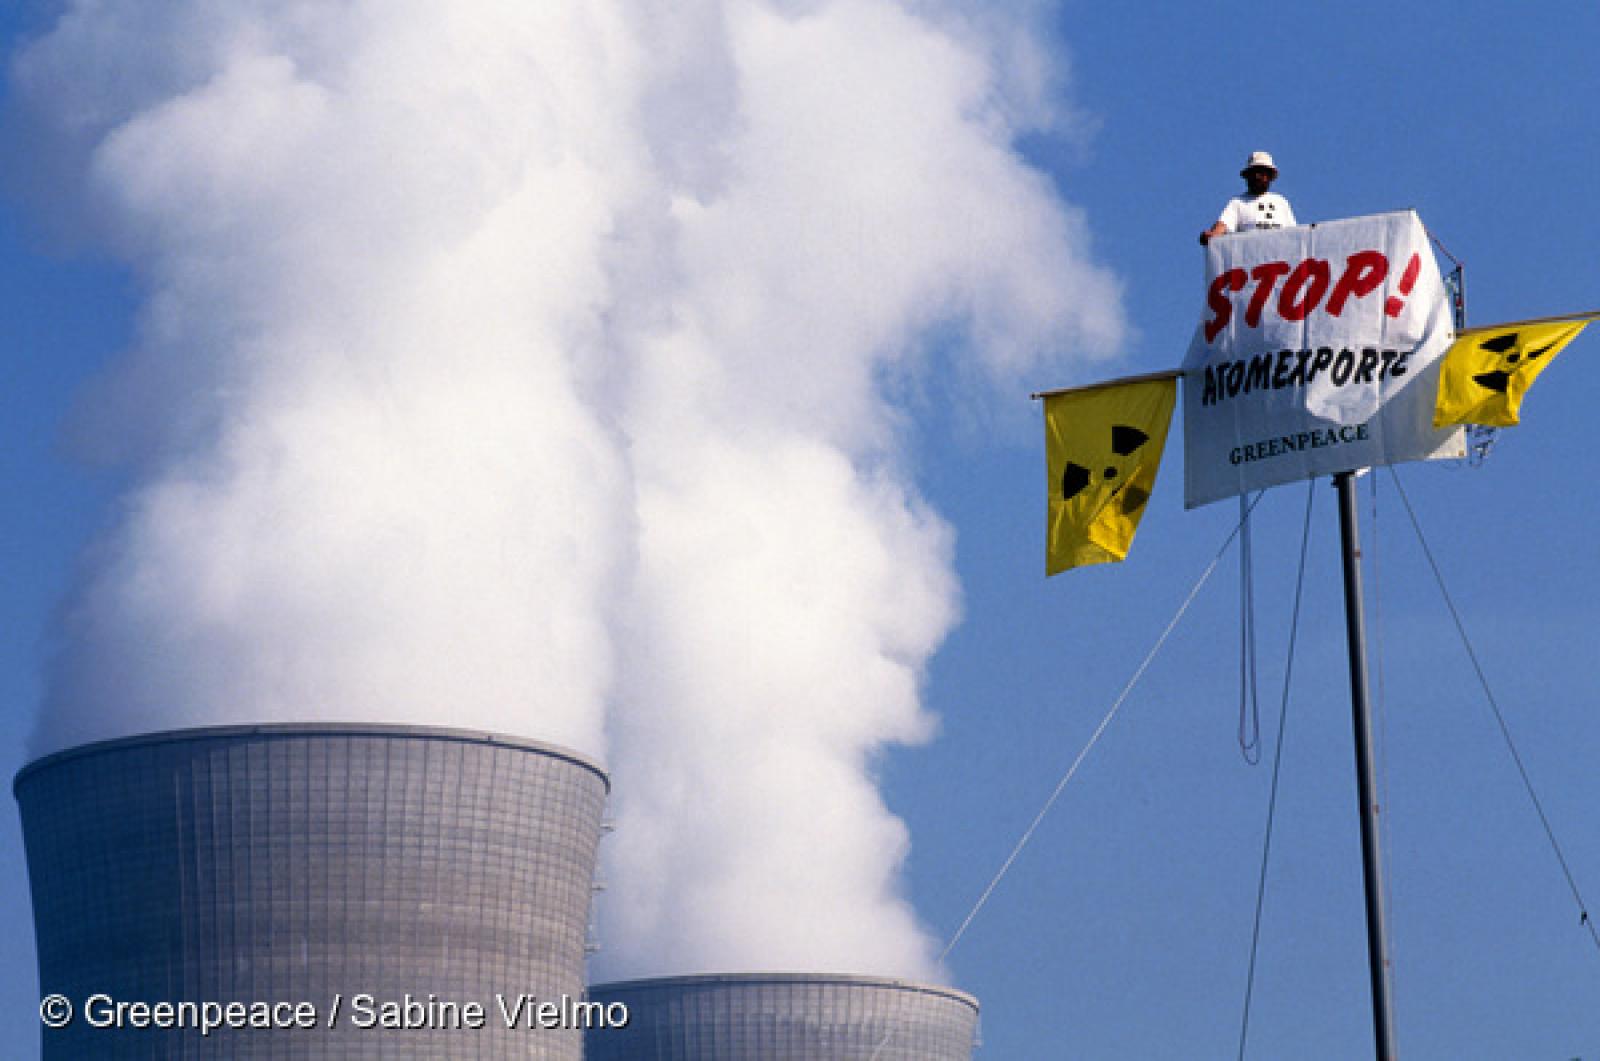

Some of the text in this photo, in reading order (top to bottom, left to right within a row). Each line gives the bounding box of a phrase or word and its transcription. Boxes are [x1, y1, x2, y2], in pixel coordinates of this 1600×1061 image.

[1204, 250, 1421, 344] STOP!
[1202, 346, 1409, 405] ATOMEXPORTE
[1229, 423, 1369, 465] GREENPEACE
